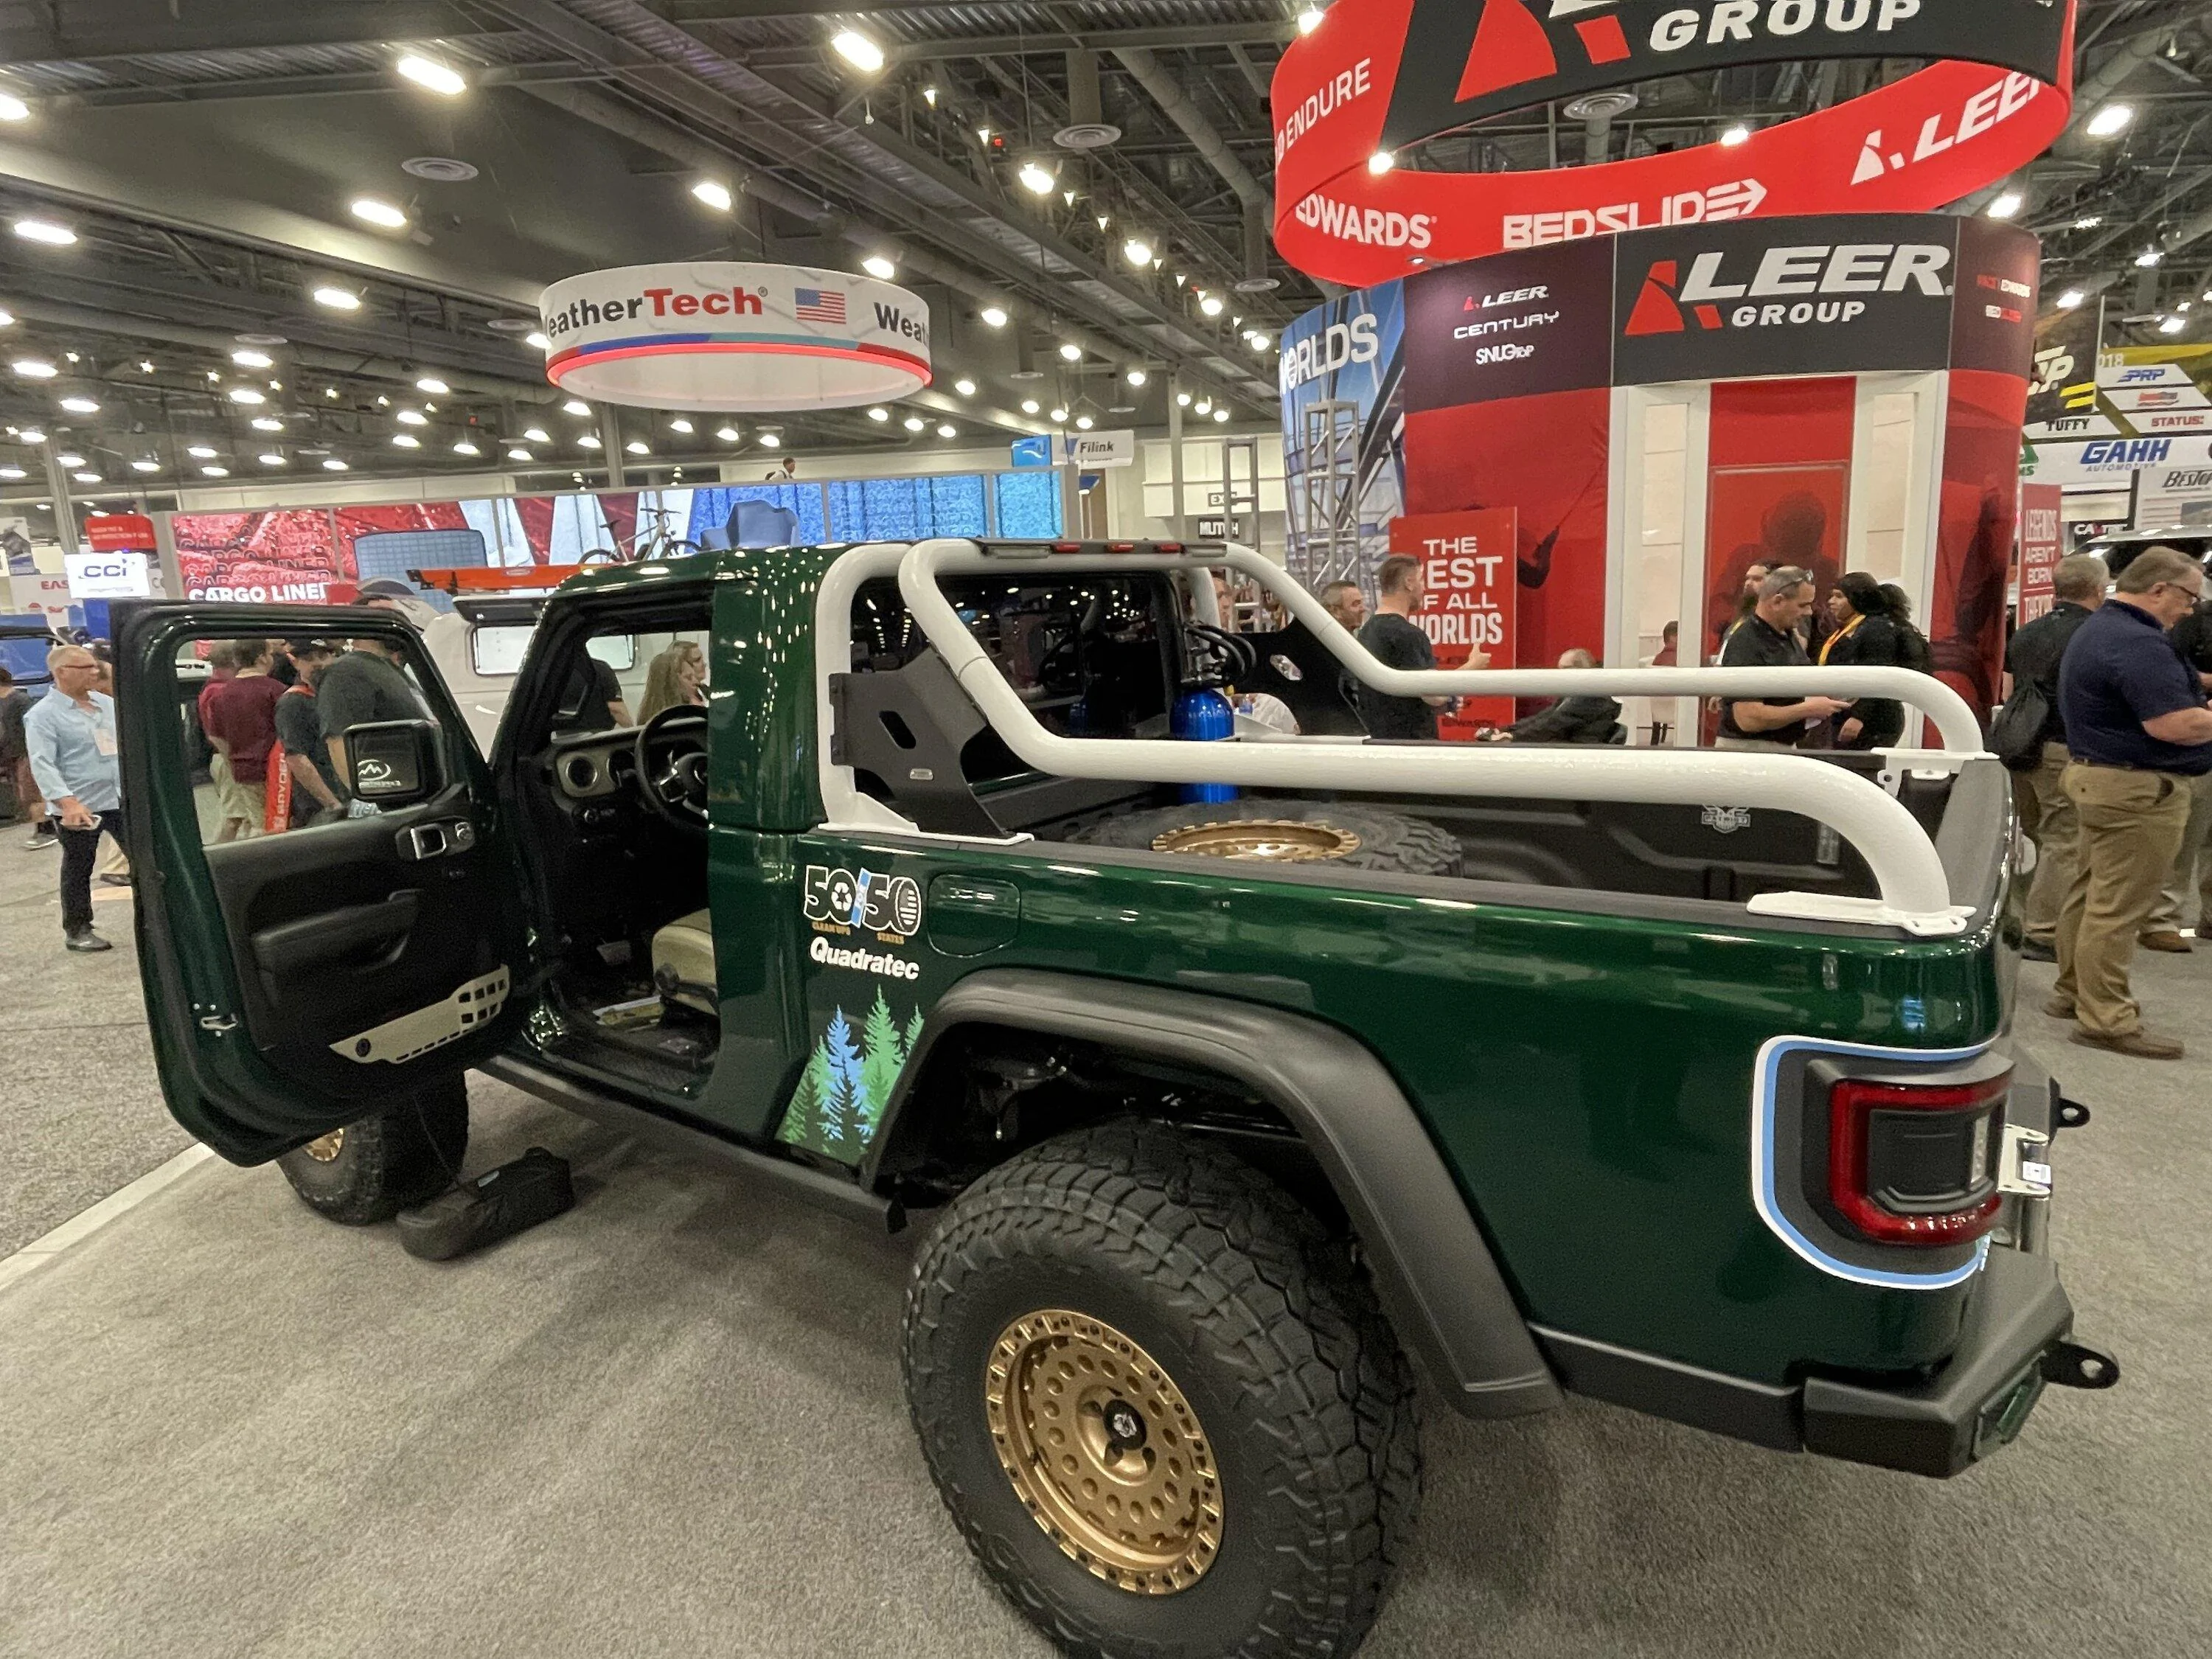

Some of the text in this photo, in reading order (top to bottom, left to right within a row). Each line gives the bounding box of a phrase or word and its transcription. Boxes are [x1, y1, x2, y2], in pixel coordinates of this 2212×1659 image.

[1649, 0, 1920, 52] GROUP
[1286, 58, 1371, 150] ENDURE
[1678, 243, 1951, 302] LEER
[1481, 285, 1549, 308] LEER
[1453, 310, 1559, 339] CENTURY
[1731, 301, 1865, 327] GROUP
[2045, 417, 2090, 431] TUFFY
[1079, 441, 1114, 453] Filink
[2079, 439, 2172, 465] GAHH
[1422, 536, 1478, 556] THE
[1421, 556, 1503, 589] EST
[188, 586, 267, 603] CARGO
[1445, 591, 1498, 611] ALL
[810, 936, 920, 980] Quadratec
